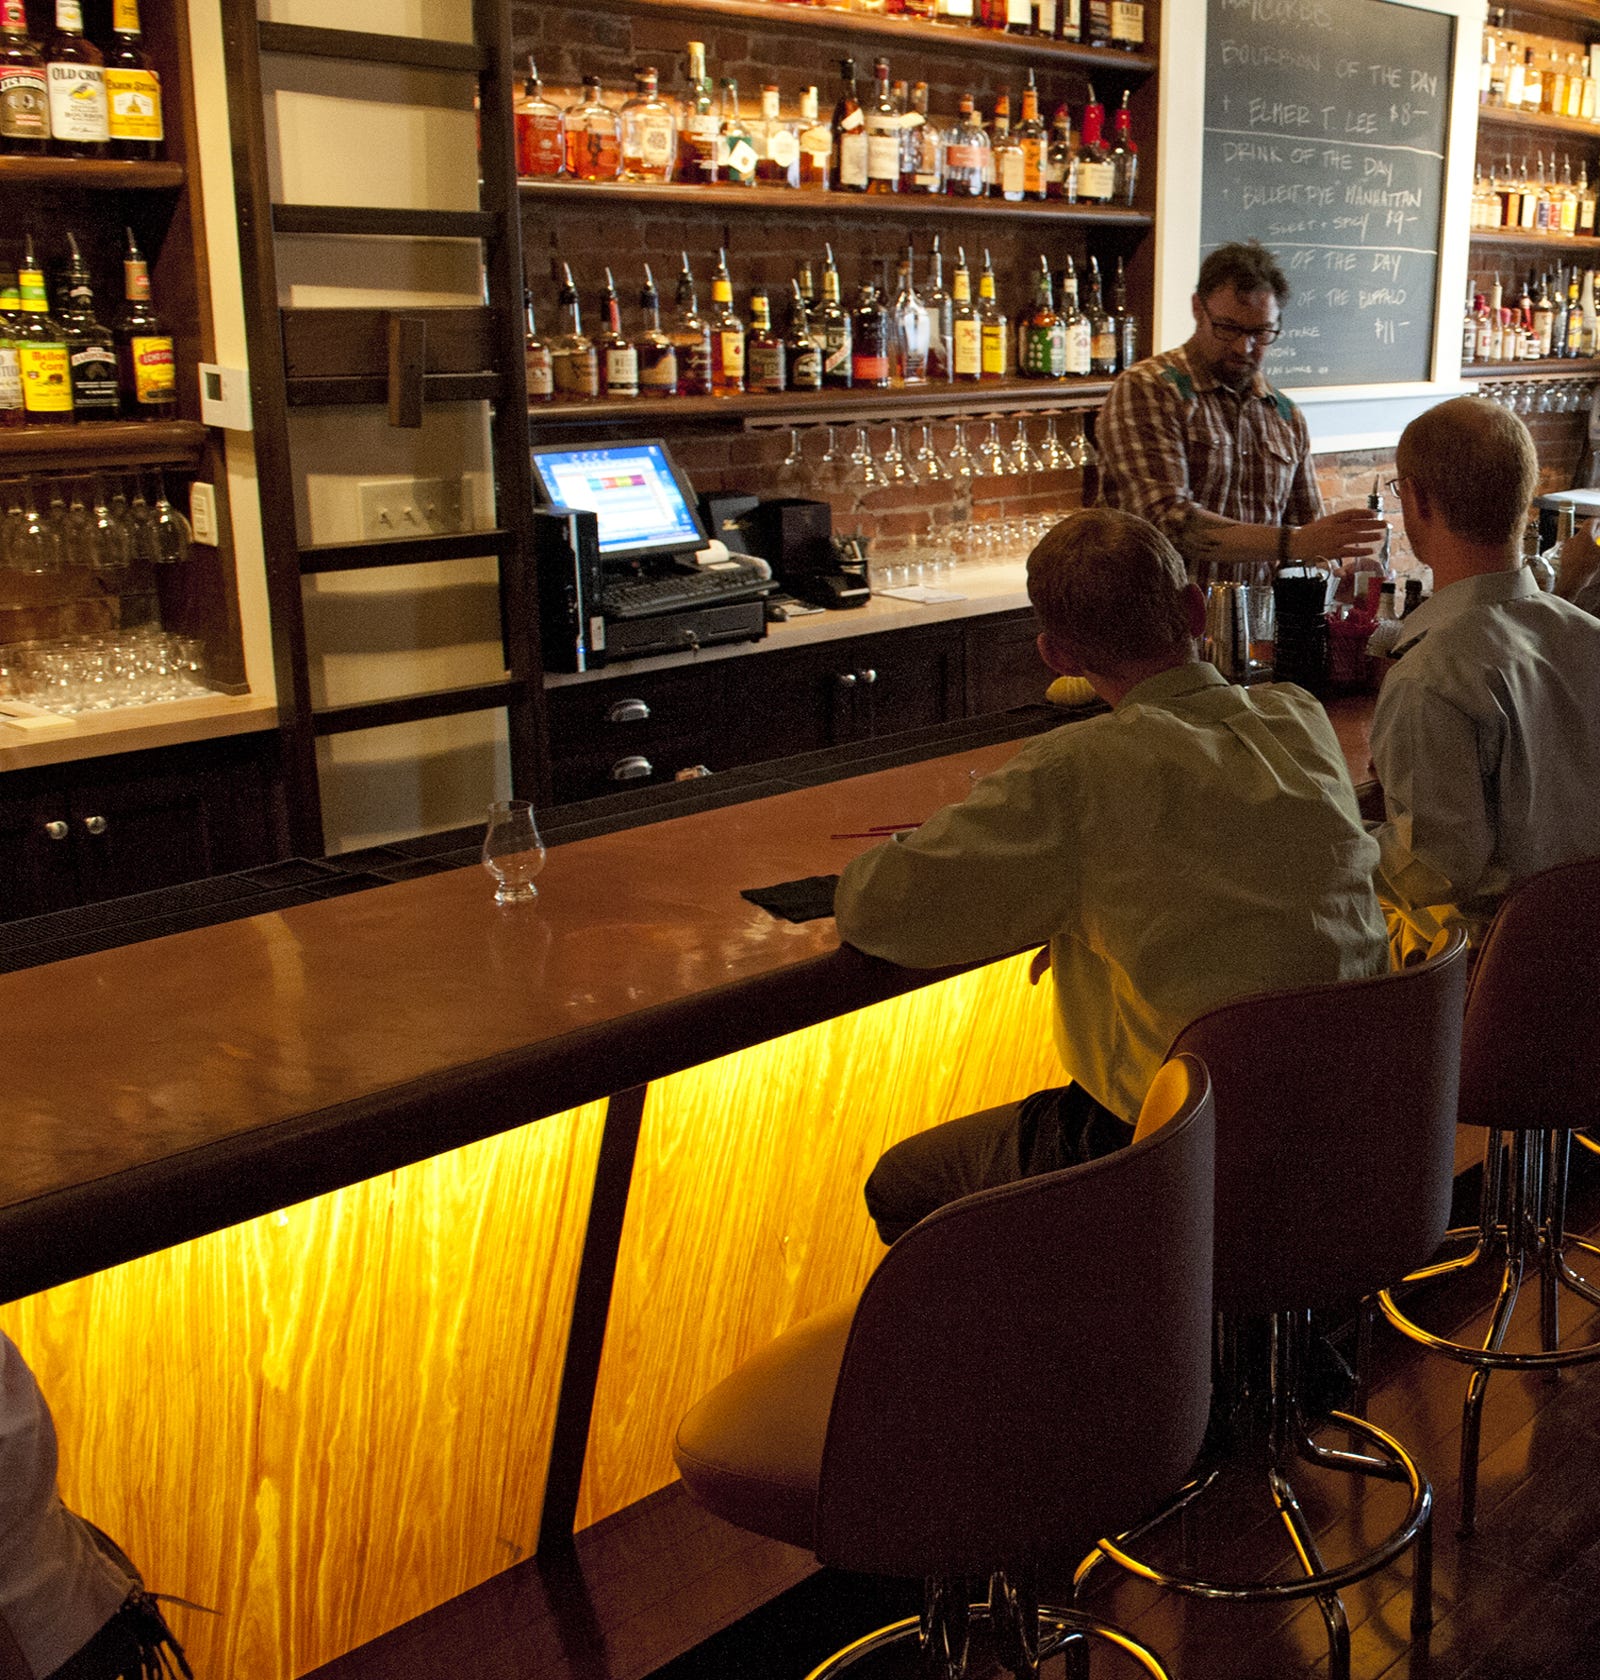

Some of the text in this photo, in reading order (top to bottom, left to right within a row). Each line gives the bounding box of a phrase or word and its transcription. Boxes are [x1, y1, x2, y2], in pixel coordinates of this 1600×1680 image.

[52, 68, 76, 81] OLD
[1221, 40, 1437, 96] BOURBON OF THE DAY
[1249, 98, 1311, 126] ELMER
[1345, 111, 1379, 134] LEE
[1222, 142, 1393, 187] DRINK OF THE DAY
[1345, 184, 1422, 208] MANHATTAN
[1268, 220, 1315, 235] SWEET
[1333, 213, 1369, 242] SPICY
[1291, 250, 1402, 282] OF THE DAY
[1297, 287, 1407, 309] OF THE BUFFALO
